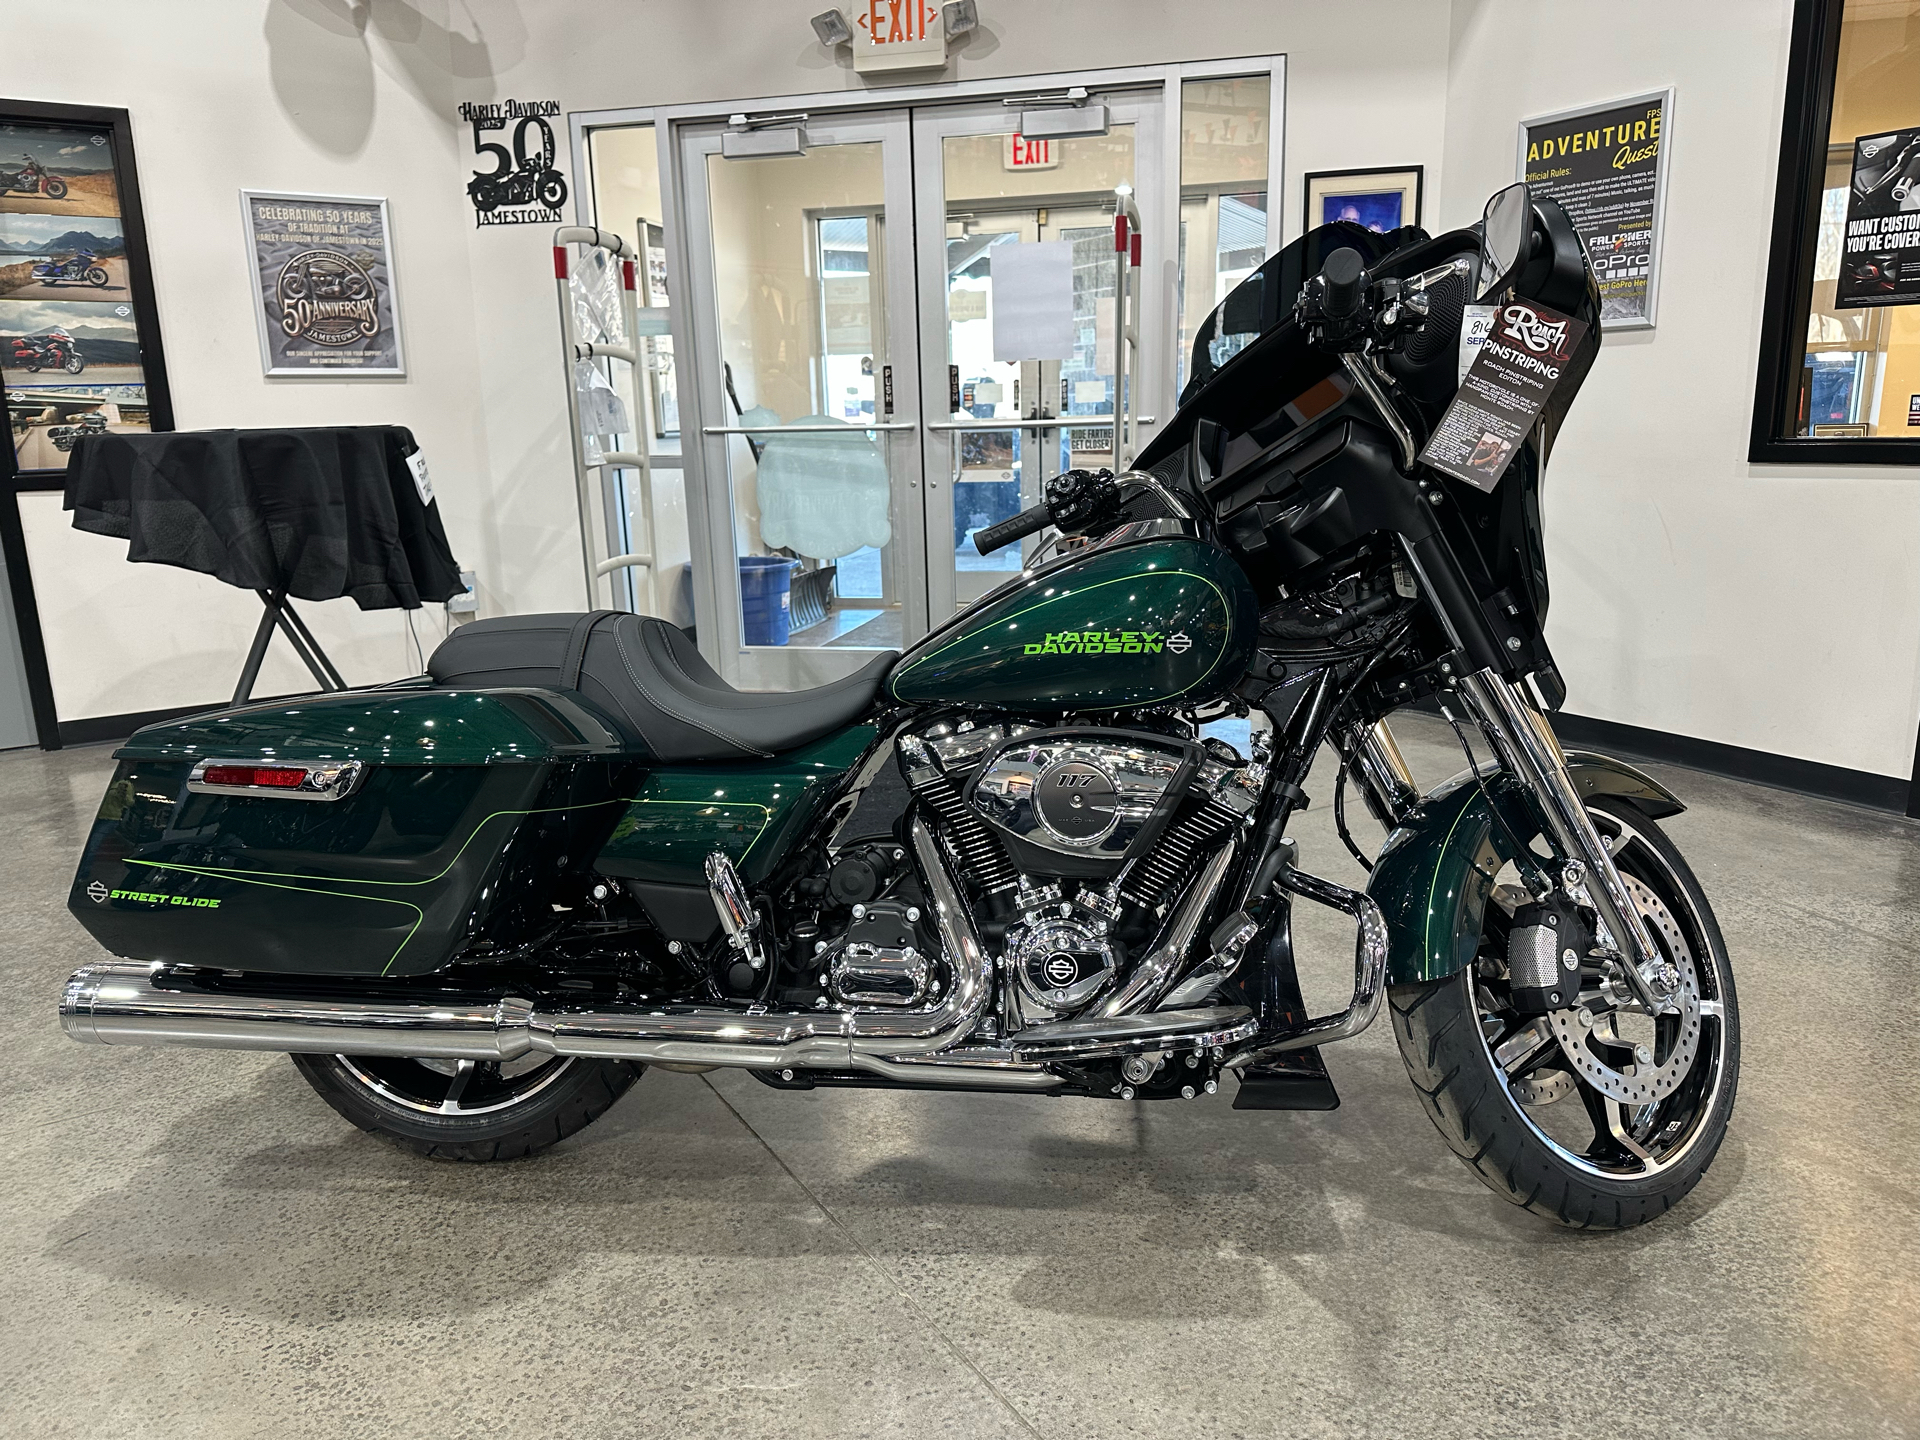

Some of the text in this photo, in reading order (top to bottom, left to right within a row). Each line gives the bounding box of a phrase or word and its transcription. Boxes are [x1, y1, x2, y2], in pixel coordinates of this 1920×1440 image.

[870, 0, 925, 45] EXIT
[459, 99, 560, 121] HARLEY DAVIDSON
[1647, 108, 1662, 119] FPS
[473, 116, 555, 175] 50
[543, 126, 551, 167] YEARS
[1527, 117, 1662, 162] ADVENTURE
[1013, 132, 1049, 165] EXIT
[1525, 167, 1572, 183] Official Rules:
[259, 207, 372, 224] CELEBRATING 50 YEARS
[475, 208, 562, 229] JAMESTOWN
[287, 223, 349, 234] OF TRADITION AT
[1618, 221, 1643, 231] Presented
[1848, 217, 1880, 236] WANT
[322, 236, 359, 245] JAMESTOWN
[1589, 230, 1652, 247] FALCONER
[1847, 230, 1920, 253] YOU'RE COVER
[1591, 244, 1614, 252] POWER
[1611, 280, 1632, 290] GoPro
[313, 298, 379, 336] ANNIVERSARY
[307, 328, 359, 343] JAMESTOWN
[1482, 339, 1560, 380] PINSTRIPING
[1482, 358, 1543, 390] ROACH PINSTRIPING
[1071, 429, 1086, 439] RIDE
[1071, 439, 1109, 450] GET CLOSER
[1045, 631, 1165, 643] HARLEY-
[1024, 642, 1163, 655] DAVIDSON
[1056, 773, 1099, 788] 117
[110, 889, 222, 908] STREET GLIDE
